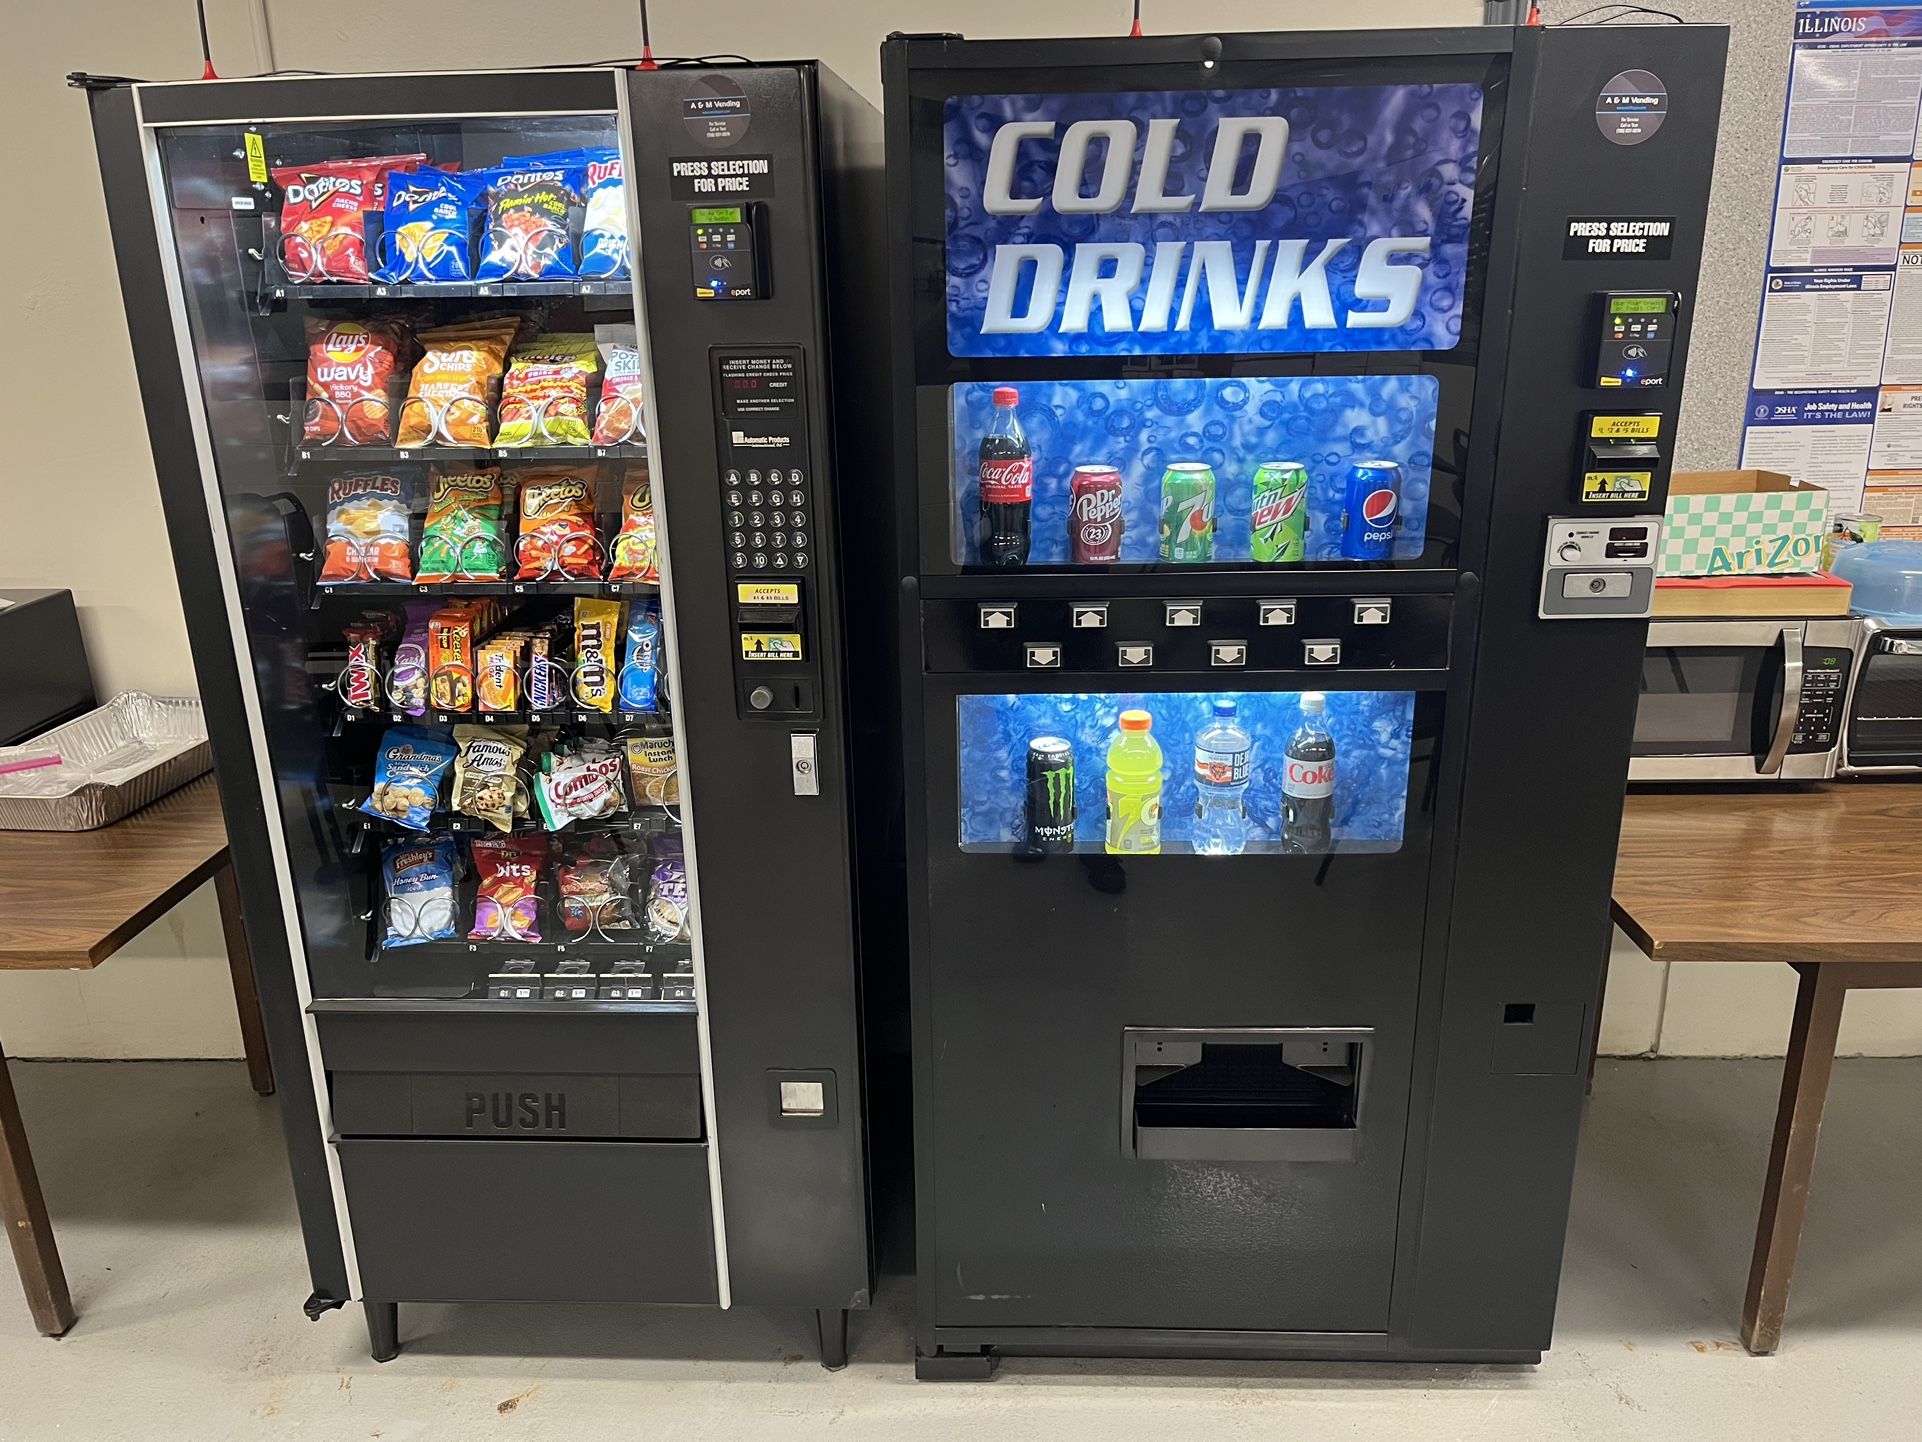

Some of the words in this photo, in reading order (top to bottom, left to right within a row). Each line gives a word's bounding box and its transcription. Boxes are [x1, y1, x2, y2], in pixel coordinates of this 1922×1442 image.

[1799, 17, 1867, 33] ILLINOIS
[714, 100, 741, 108] Vending
[1631, 96, 1659, 105] Vending
[672, 161, 709, 177] PRESS
[710, 160, 768, 176] SELECTION
[982, 115, 1290, 215] COLD
[496, 169, 566, 188] Doritos
[694, 178, 716, 193] FOR
[717, 176, 750, 192] PRICE
[287, 176, 363, 204] Doritos
[1569, 222, 1607, 237] PRESS
[1609, 222, 1671, 237] SELECTION
[1587, 239, 1612, 253] FOR
[1612, 239, 1648, 253] PRICE
[980, 235, 1432, 334] DRINKS
[275, 289, 285, 298] A1
[376, 287, 387, 296] A3
[479, 286, 489, 295] A5
[581, 286, 591, 295] A7
[730, 287, 752, 297] eport
[326, 332, 368, 354] Lay's
[439, 362, 473, 372] CHIPS
[317, 365, 374, 386] wavy
[1640, 377, 1663, 387] eport
[334, 391, 352, 399] BBQ
[1774, 406, 1797, 414] OSHA
[1804, 402, 1817, 411] Job
[1817, 402, 1839, 411] Safety
[1838, 402, 1851, 410] and
[1851, 401, 1873, 409] Health
[1803, 411, 1822, 419] IT'S
[400, 450, 409, 459] B3
[498, 449, 508, 457] B5
[597, 449, 606, 457] B7
[979, 461, 1031, 485] Coca-Cola
[329, 475, 401, 504] RUFFLES
[1095, 489, 1116, 507] Dr
[1588, 491, 1609, 499] INSERT
[1609, 491, 1622, 499] BILL
[1623, 491, 1640, 499] HERE
[1082, 493, 1122, 523] Pepper
[1089, 527, 1102, 540] 23
[1363, 530, 1393, 543] pepsi
[754, 557, 765, 565] 10
[324, 586, 333, 594] C1
[419, 585, 428, 593] C3
[514, 585, 524, 593] C5
[748, 650, 767, 658] INSERT
[348, 642, 372, 705] TWIX
[532, 656, 549, 709] SNICKERS
[625, 714, 634, 722] D7
[459, 737, 513, 758] Famous
[641, 738, 675, 750] Maruch
[384, 747, 442, 763] Grandma's
[644, 749, 676, 758] Instant
[462, 753, 503, 769] Amos
[648, 755, 673, 763] Lunch
[386, 763, 430, 772] Sandwich
[631, 764, 652, 773] Roast
[553, 757, 618, 800] Combos
[1288, 763, 1335, 785] Coke
[363, 822, 371, 830] E1
[452, 822, 461, 830] E3
[395, 851, 433, 870] Freshley's
[393, 876, 419, 887] Honey
[419, 873, 438, 882] Bun
[469, 944, 477, 952] F3
[645, 945, 654, 953] F7
[499, 989, 509, 997] G1
[555, 989, 565, 997] G2
[611, 989, 620, 997] G3
[675, 989, 685, 997] G4
[465, 1092, 566, 1130] PUSH
